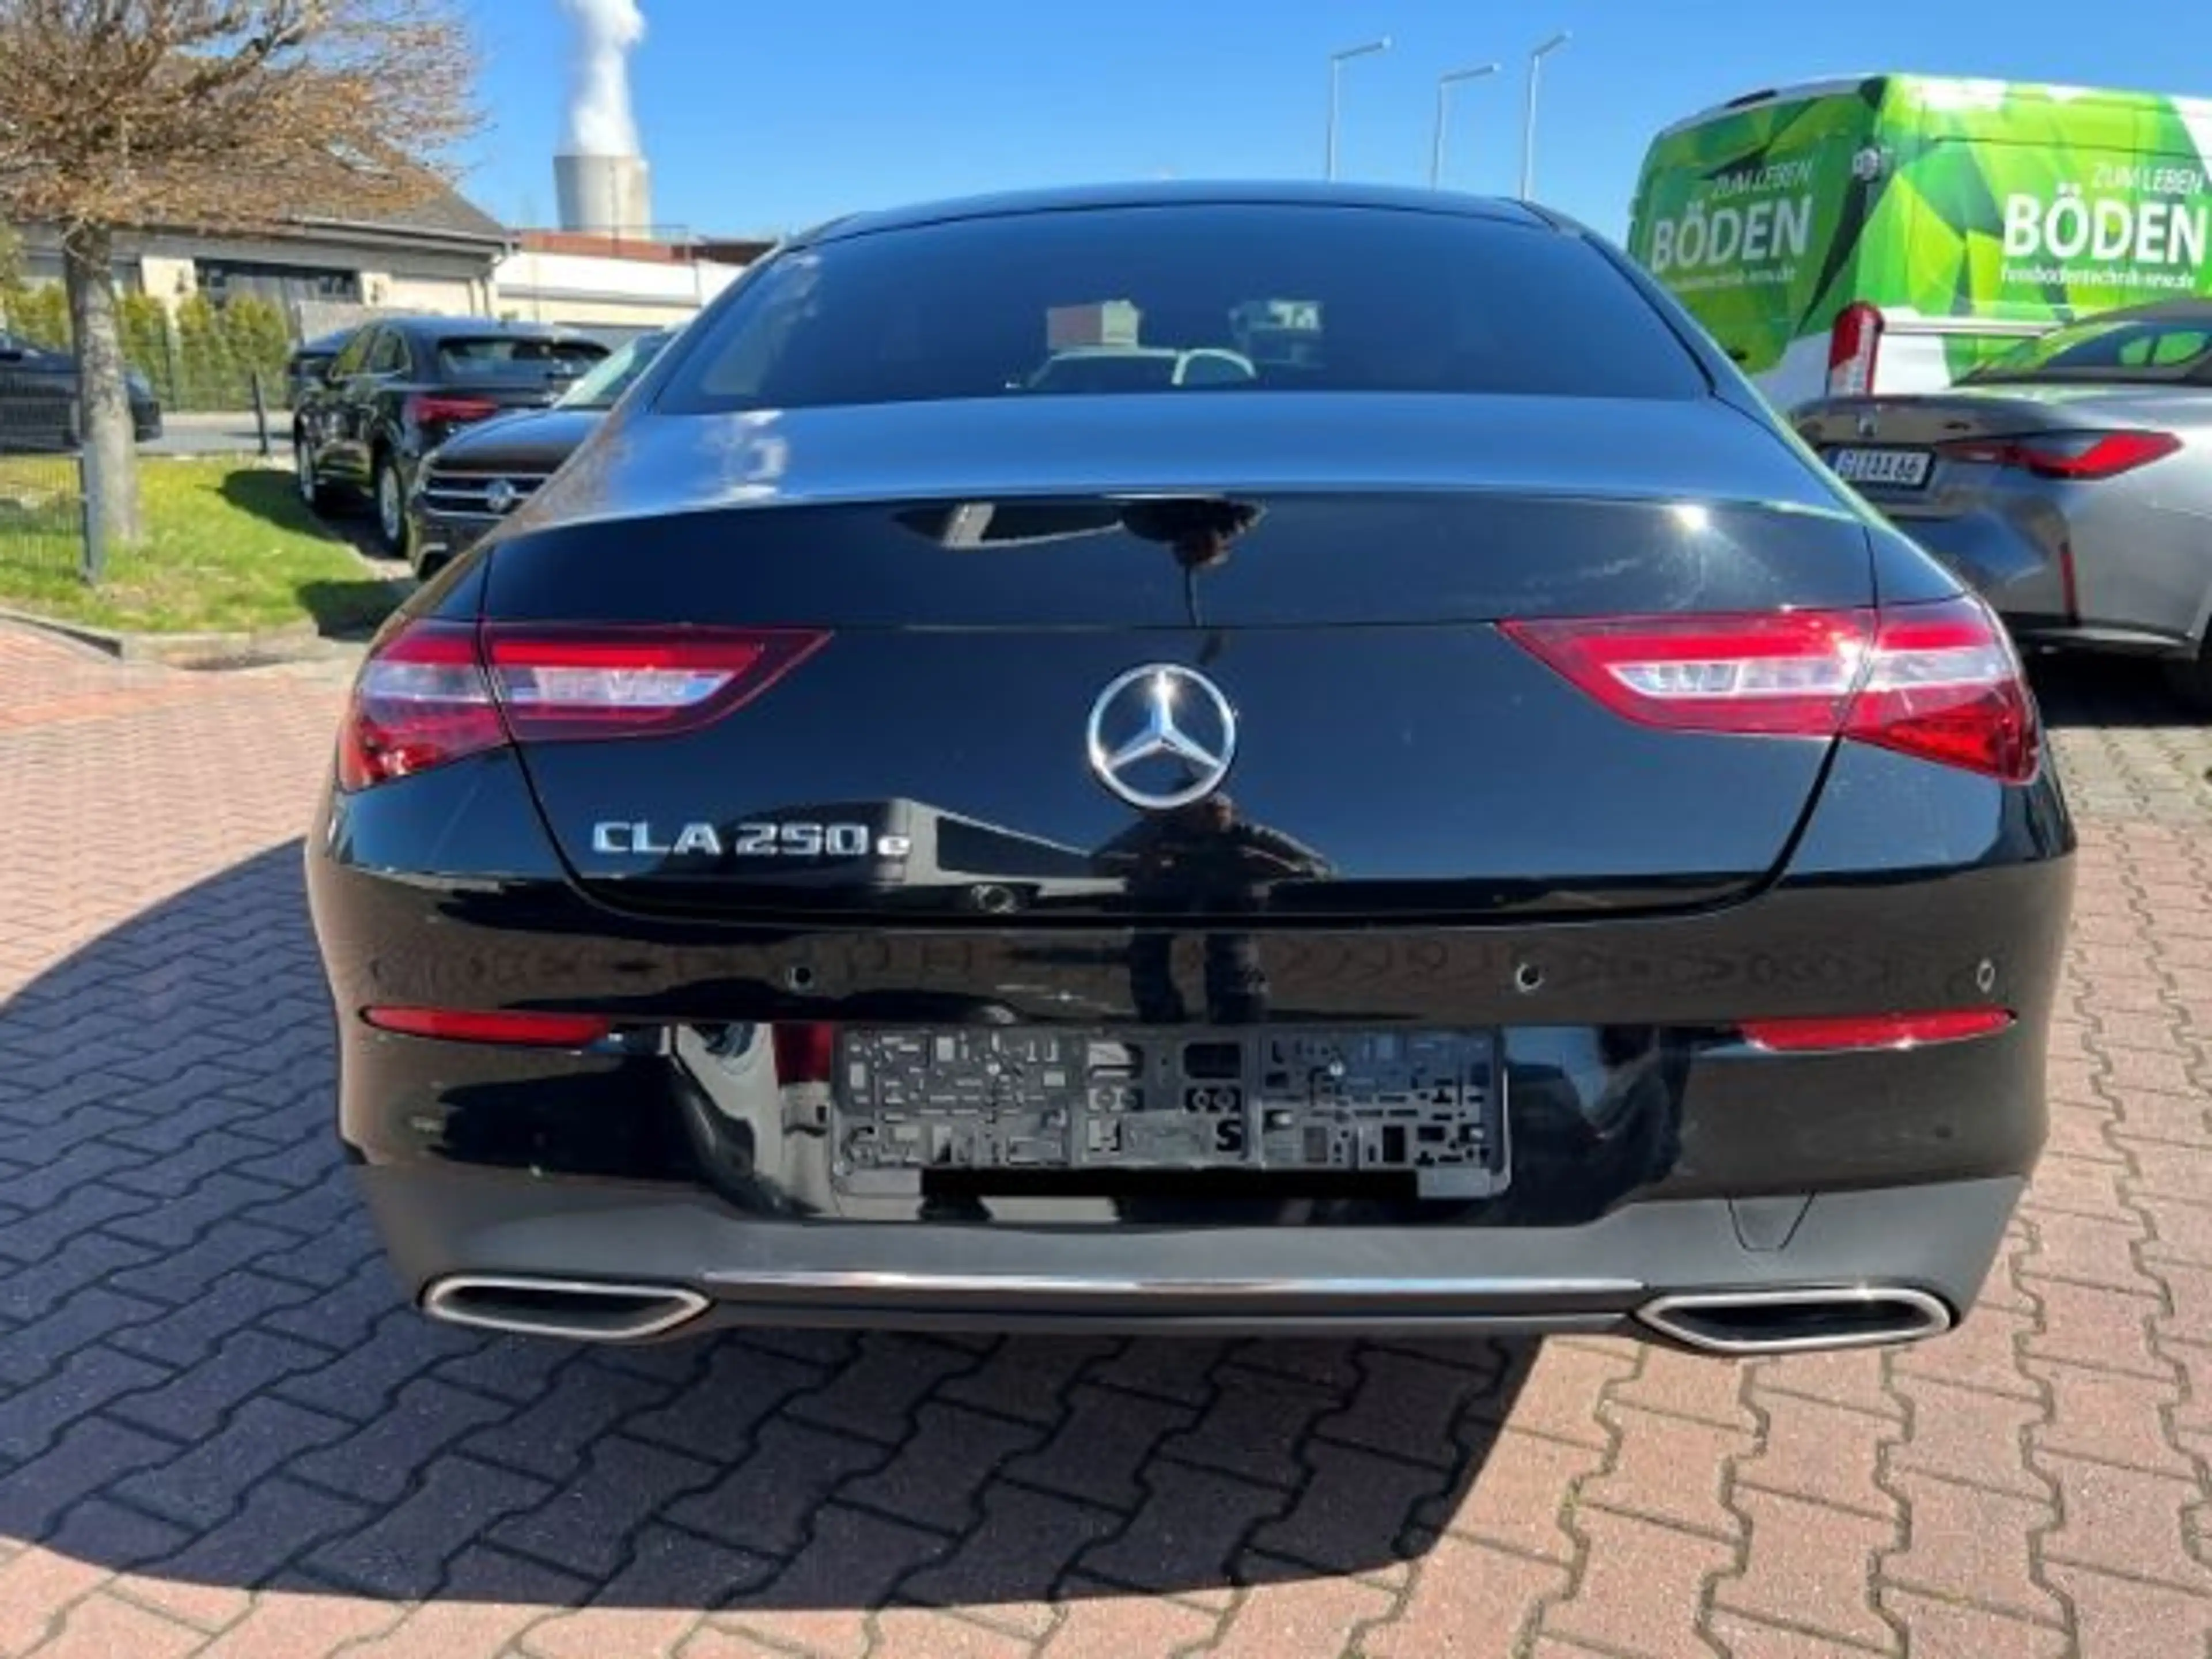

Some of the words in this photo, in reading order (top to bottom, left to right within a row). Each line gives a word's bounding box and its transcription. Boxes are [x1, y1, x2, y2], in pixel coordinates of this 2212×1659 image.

[1711, 169, 1753, 200] ZUM
[1751, 159, 1813, 191] LEBEN
[2091, 160, 2137, 189] ZUM
[2142, 166, 2205, 195] LEBEN
[1651, 194, 1813, 274] BÖDEN
[2002, 181, 2208, 267] BÖDEN
[592, 820, 721, 856] CLA
